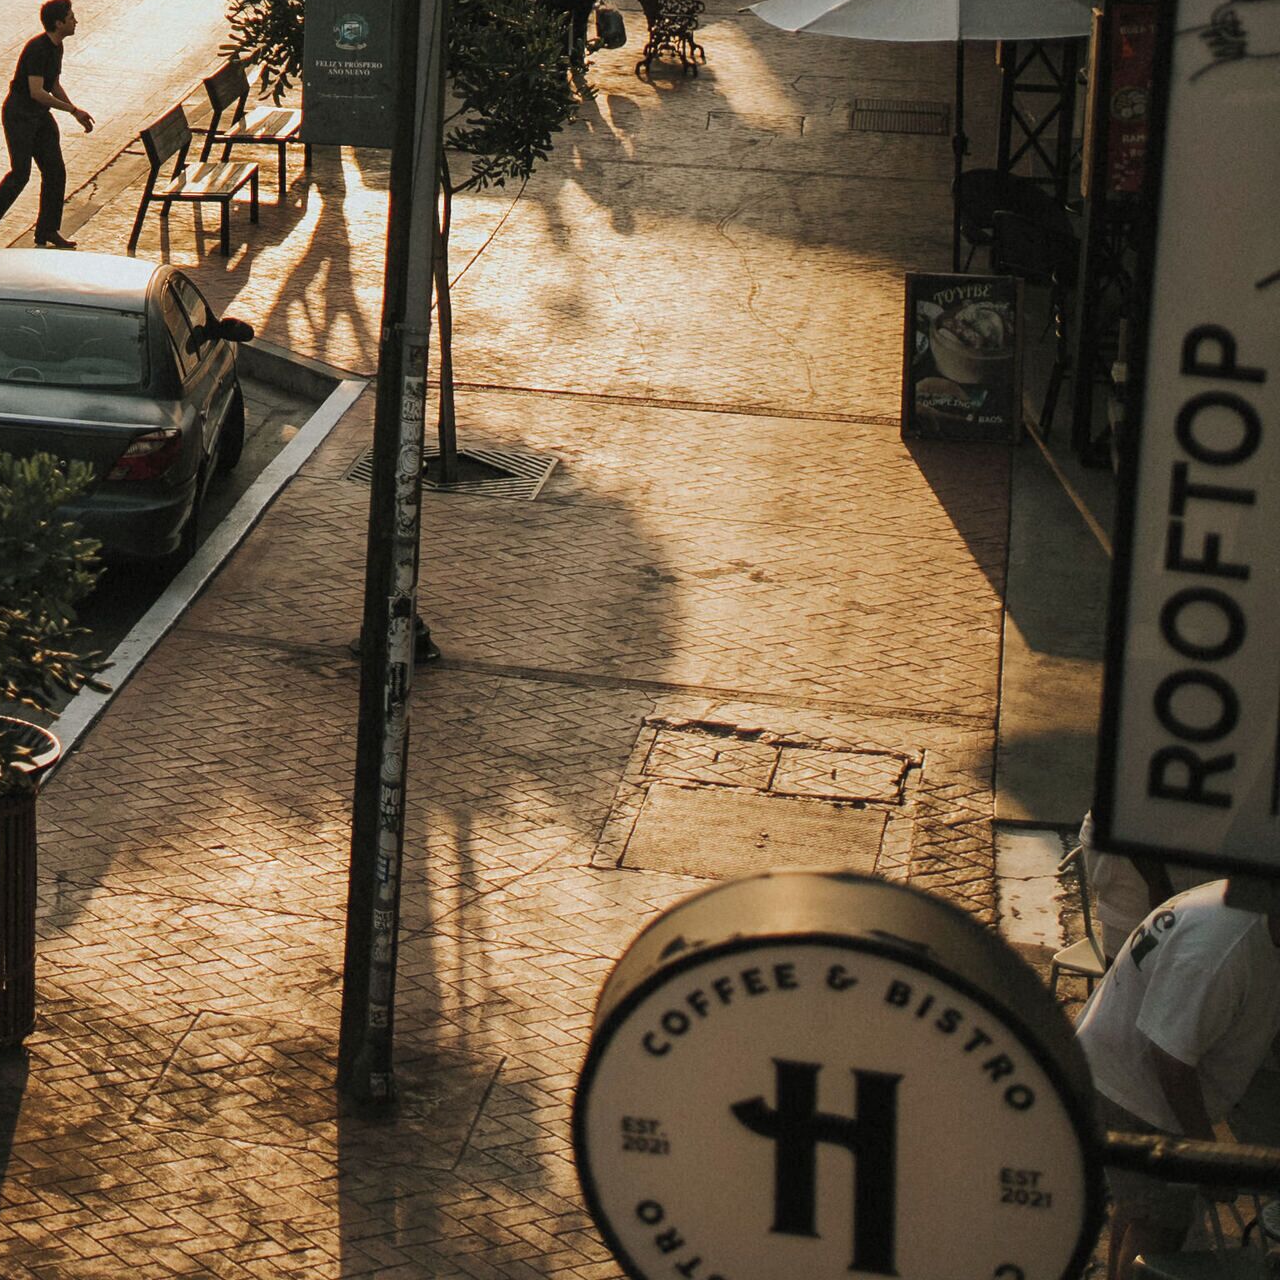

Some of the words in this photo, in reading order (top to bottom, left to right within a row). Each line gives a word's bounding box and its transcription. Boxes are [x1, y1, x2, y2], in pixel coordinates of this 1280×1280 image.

[345, 68, 371, 76] NUEVO
[1147, 323, 1268, 809] ROOFTOP
[643, 962, 800, 1059] COFFEE
[825, 963, 859, 992] &
[884, 978, 1037, 1114] BISTRO
[1001, 1187, 1053, 1209] 2021
